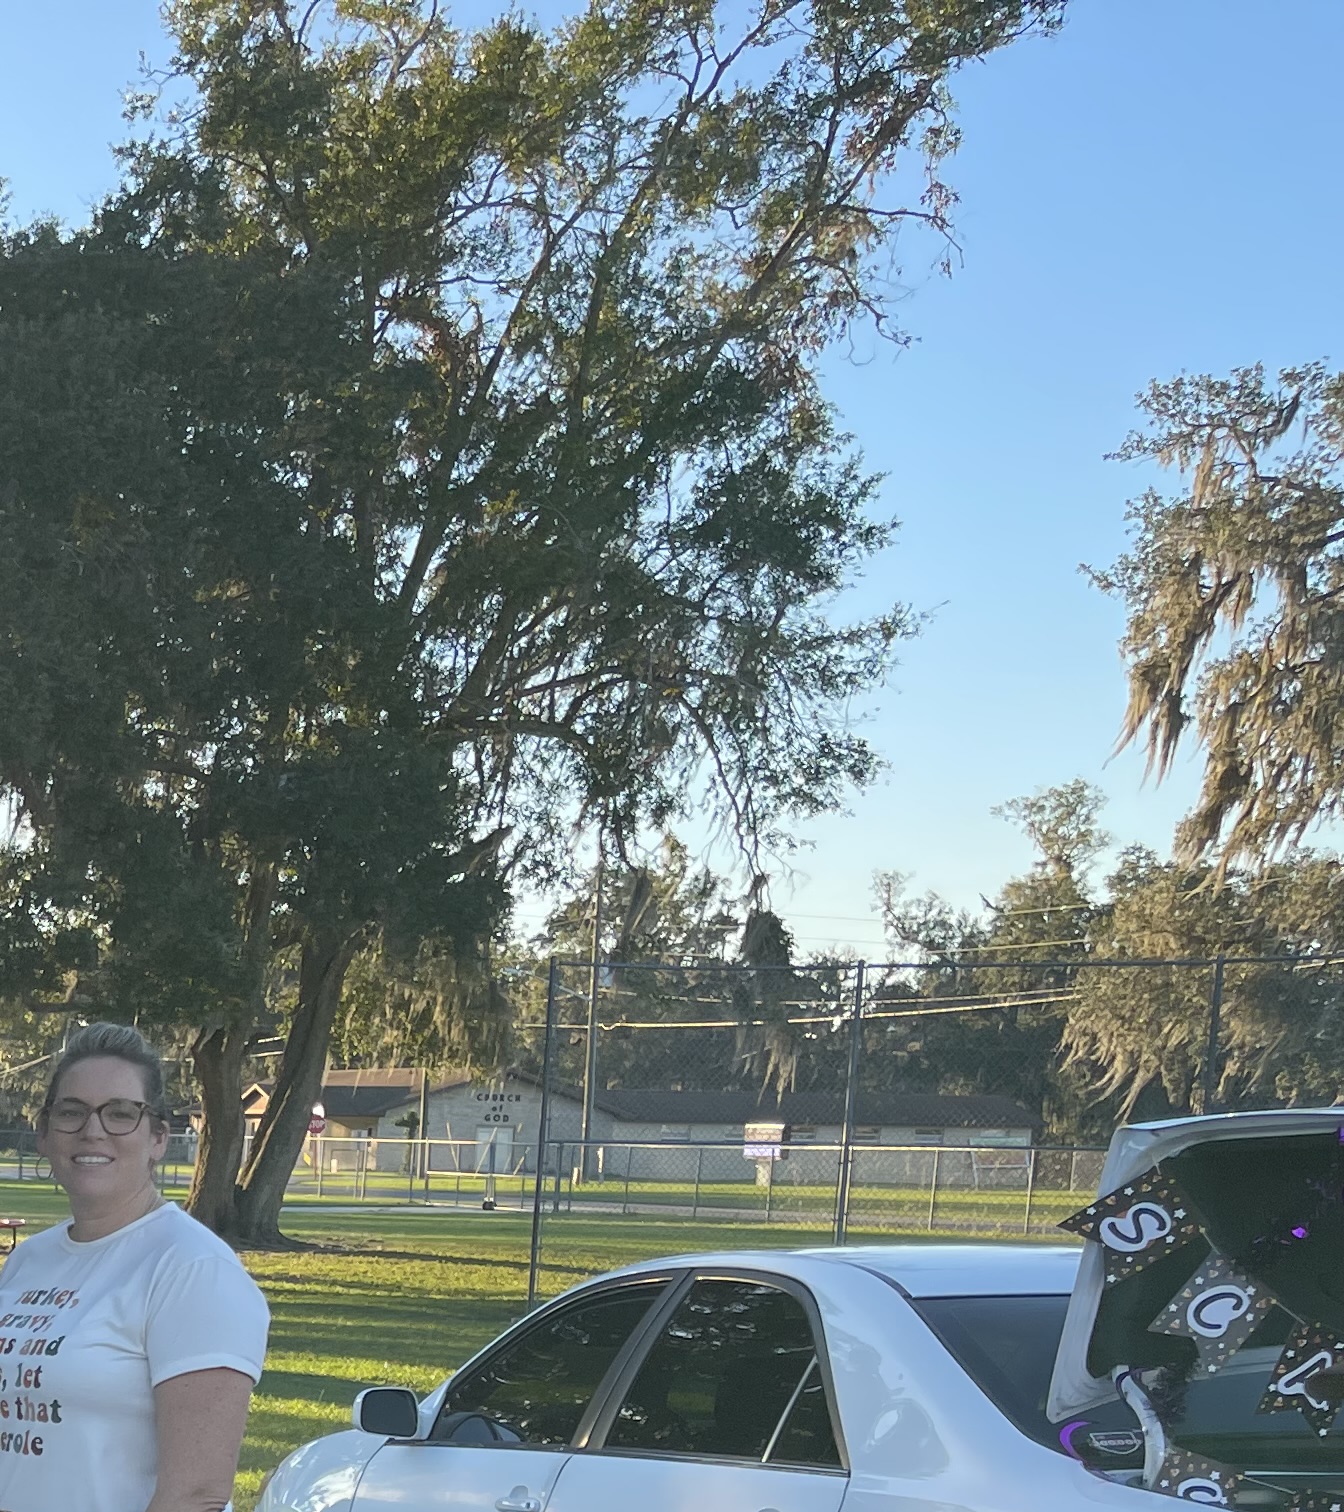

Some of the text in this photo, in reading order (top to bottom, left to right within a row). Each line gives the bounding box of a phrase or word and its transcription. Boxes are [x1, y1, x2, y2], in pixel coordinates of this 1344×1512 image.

[476, 1093, 521, 1103] CHURCH
[484, 1113, 510, 1123] GOD
[19, 1335, 66, 1356] and
[14, 1362, 43, 1389] let
[14, 1396, 63, 1424] that
